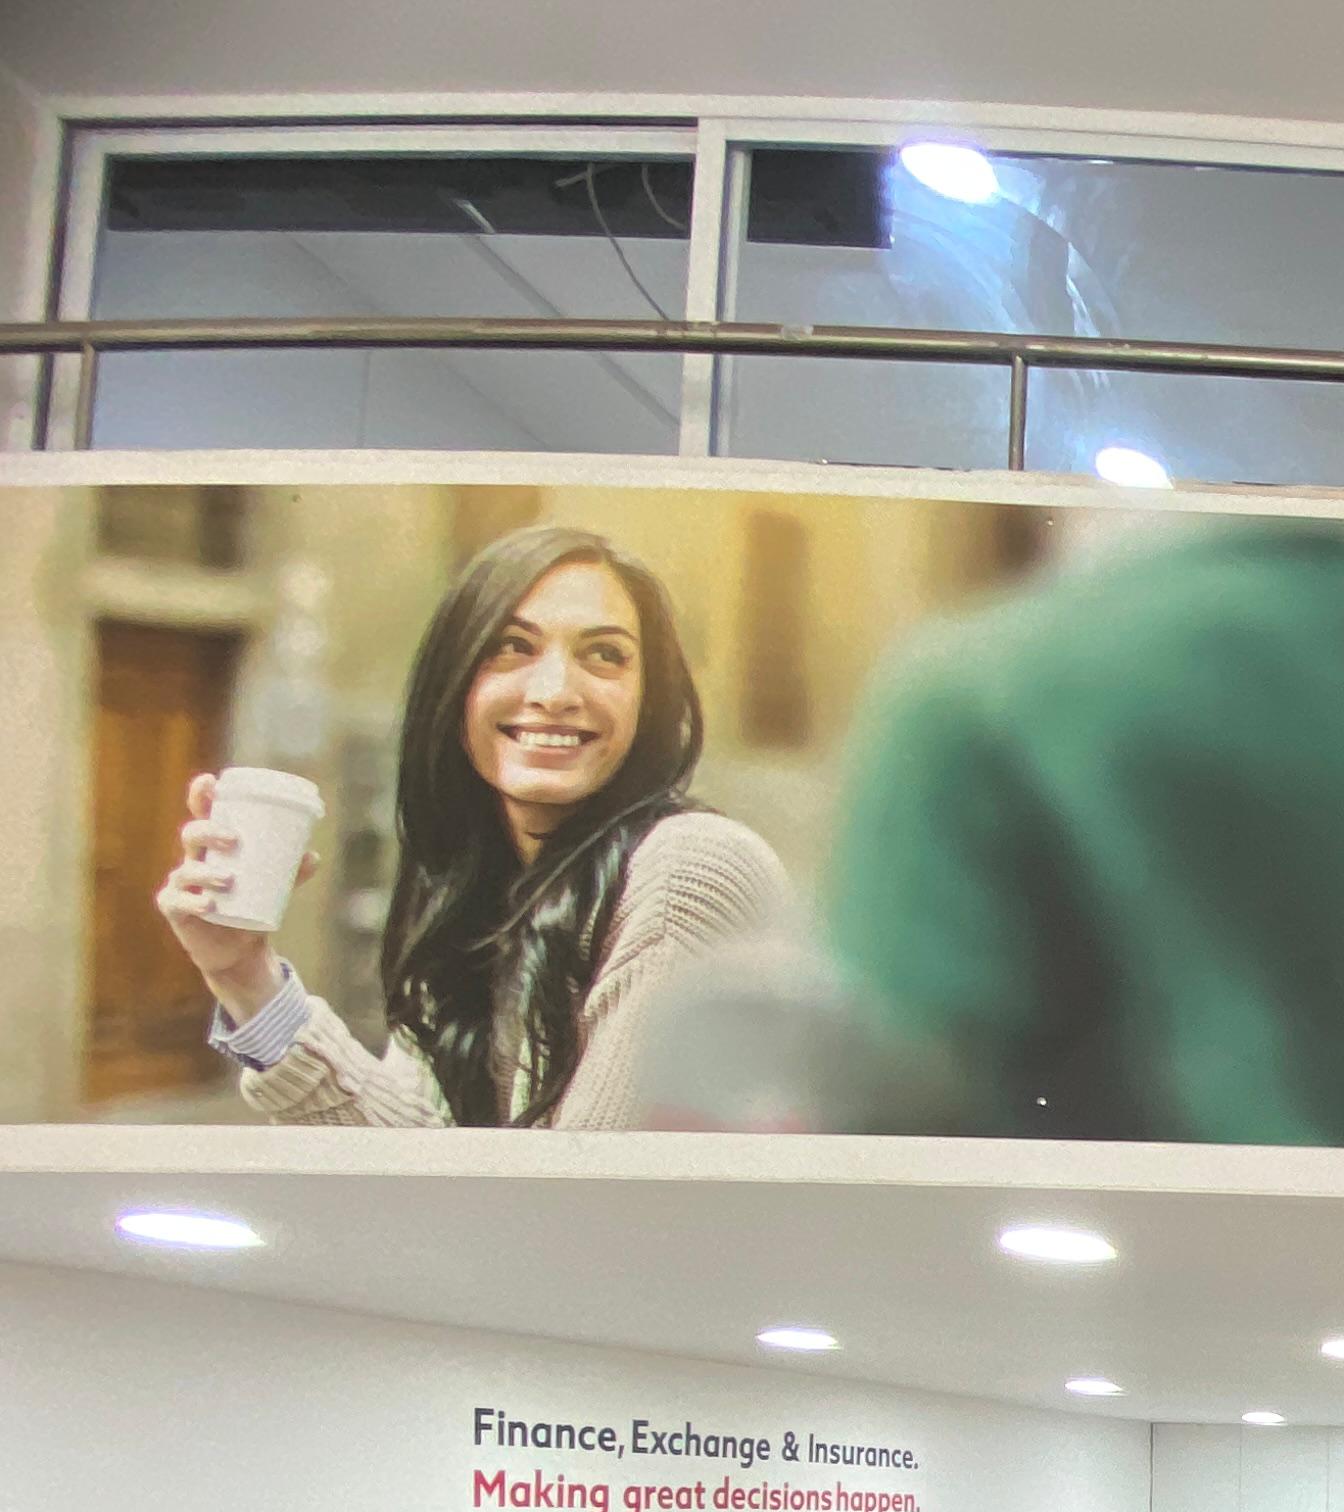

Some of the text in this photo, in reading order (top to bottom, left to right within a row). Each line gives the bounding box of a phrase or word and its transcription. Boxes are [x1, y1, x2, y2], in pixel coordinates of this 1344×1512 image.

[474, 1407, 919, 1470] Finance, Exchange & Insurance.
[713, 1476, 833, 1511] decisions
